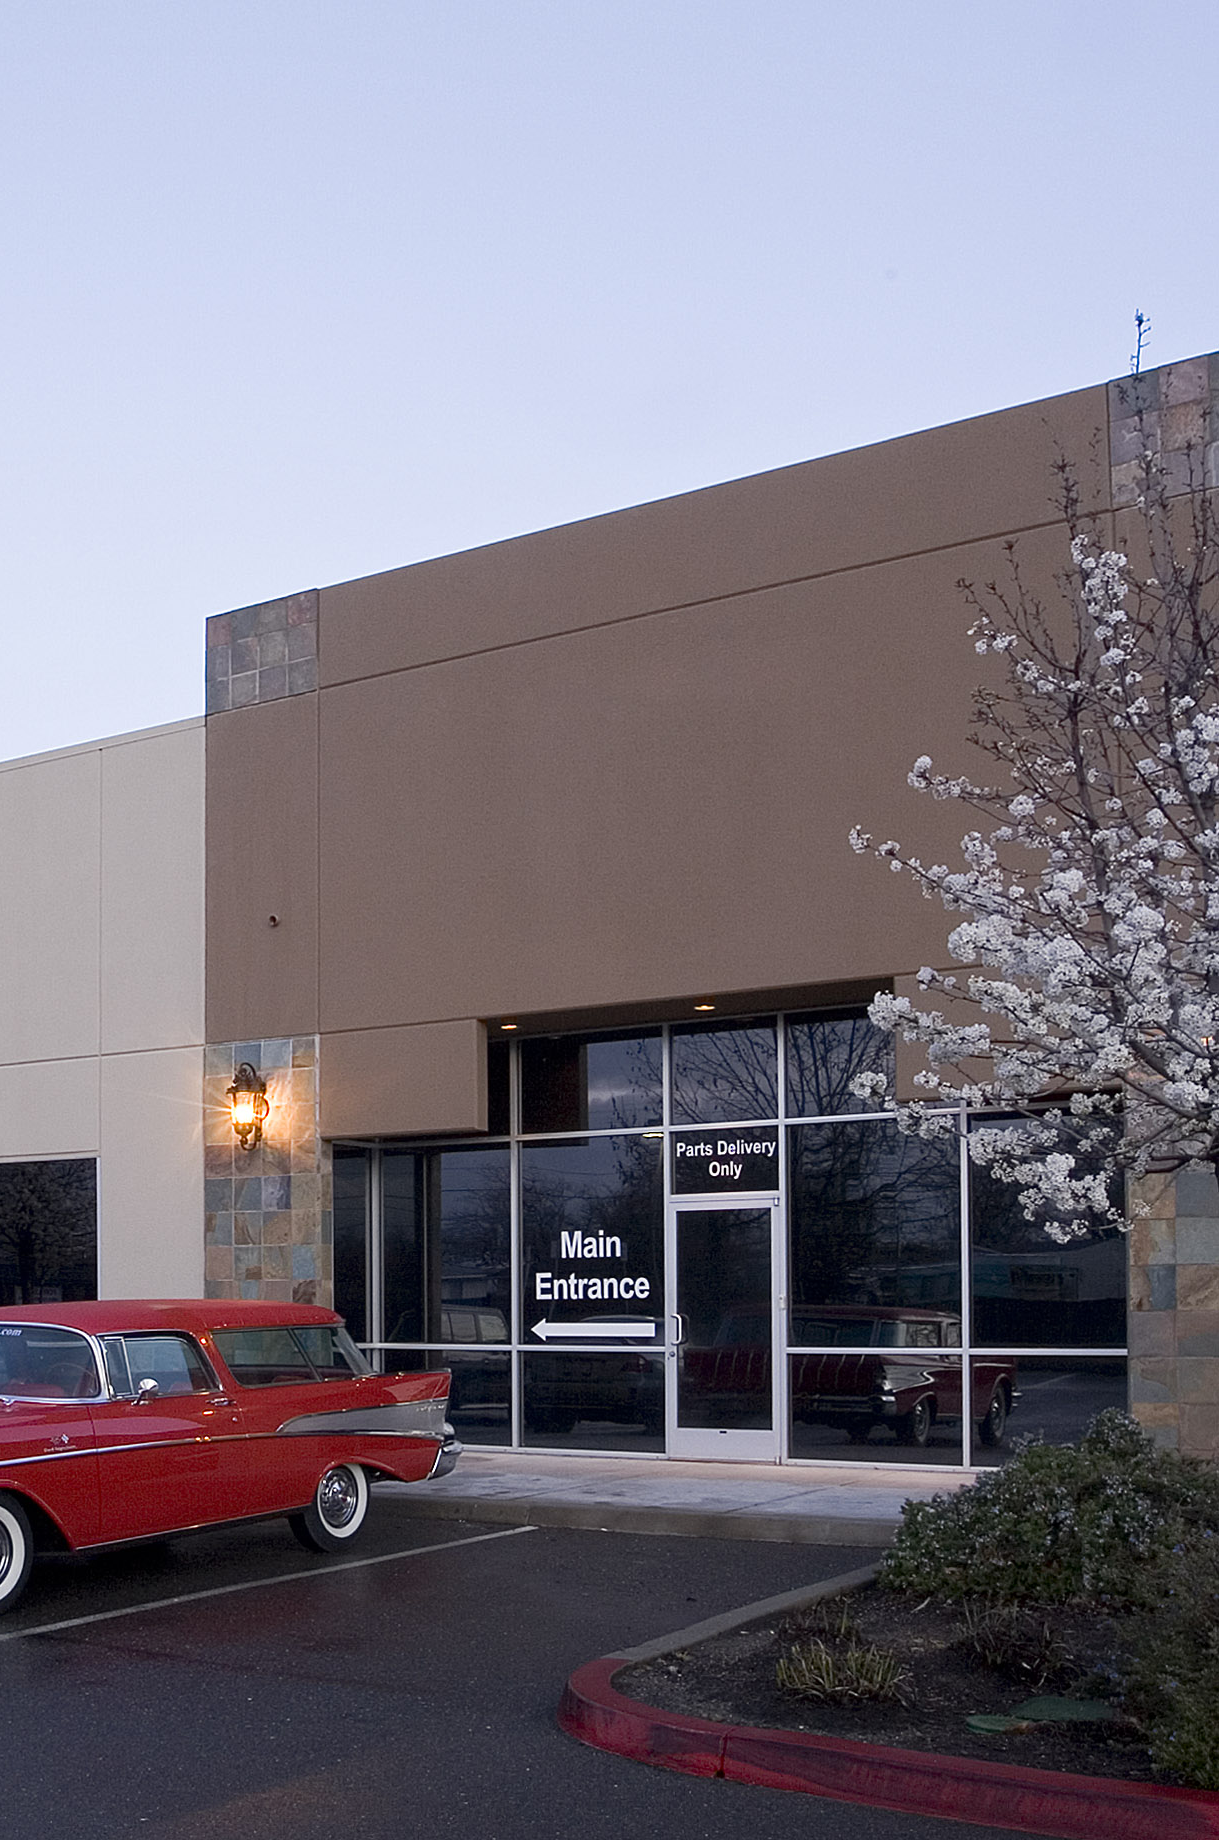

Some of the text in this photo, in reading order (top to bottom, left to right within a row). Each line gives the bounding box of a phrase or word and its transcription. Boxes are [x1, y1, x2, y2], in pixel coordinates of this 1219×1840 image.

[676, 1139, 777, 1158] Parts Delivery
[708, 1161, 743, 1179] Only
[560, 1229, 622, 1258] Main
[535, 1271, 651, 1301] Entrance
